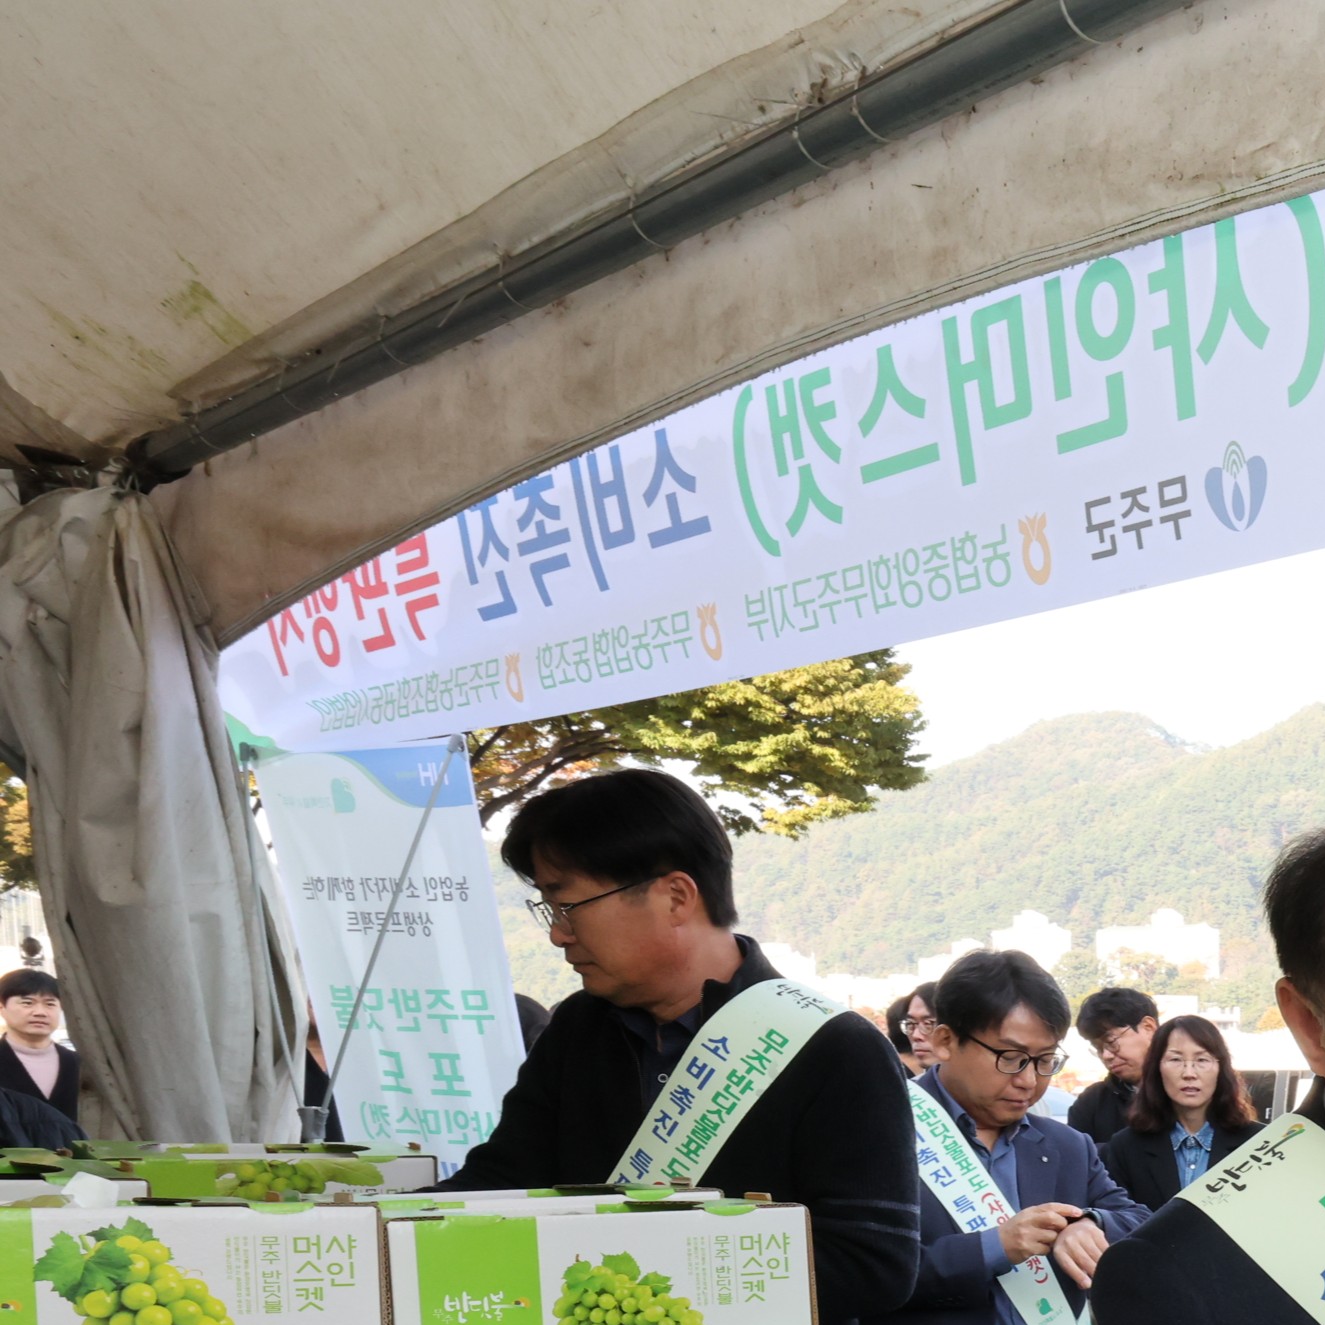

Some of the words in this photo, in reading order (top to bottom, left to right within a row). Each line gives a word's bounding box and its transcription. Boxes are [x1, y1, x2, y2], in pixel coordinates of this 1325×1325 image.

[653, 1028, 789, 1185] 무주반딧불포도
[261, 1236, 281, 1265] 무주
[325, 1234, 357, 1287] 샤인
[713, 1235, 730, 1261] 무주
[765, 1232, 791, 1279] 샤인
[262, 1270, 282, 1314] 반딧불
[715, 1265, 733, 1305] 반딧불
